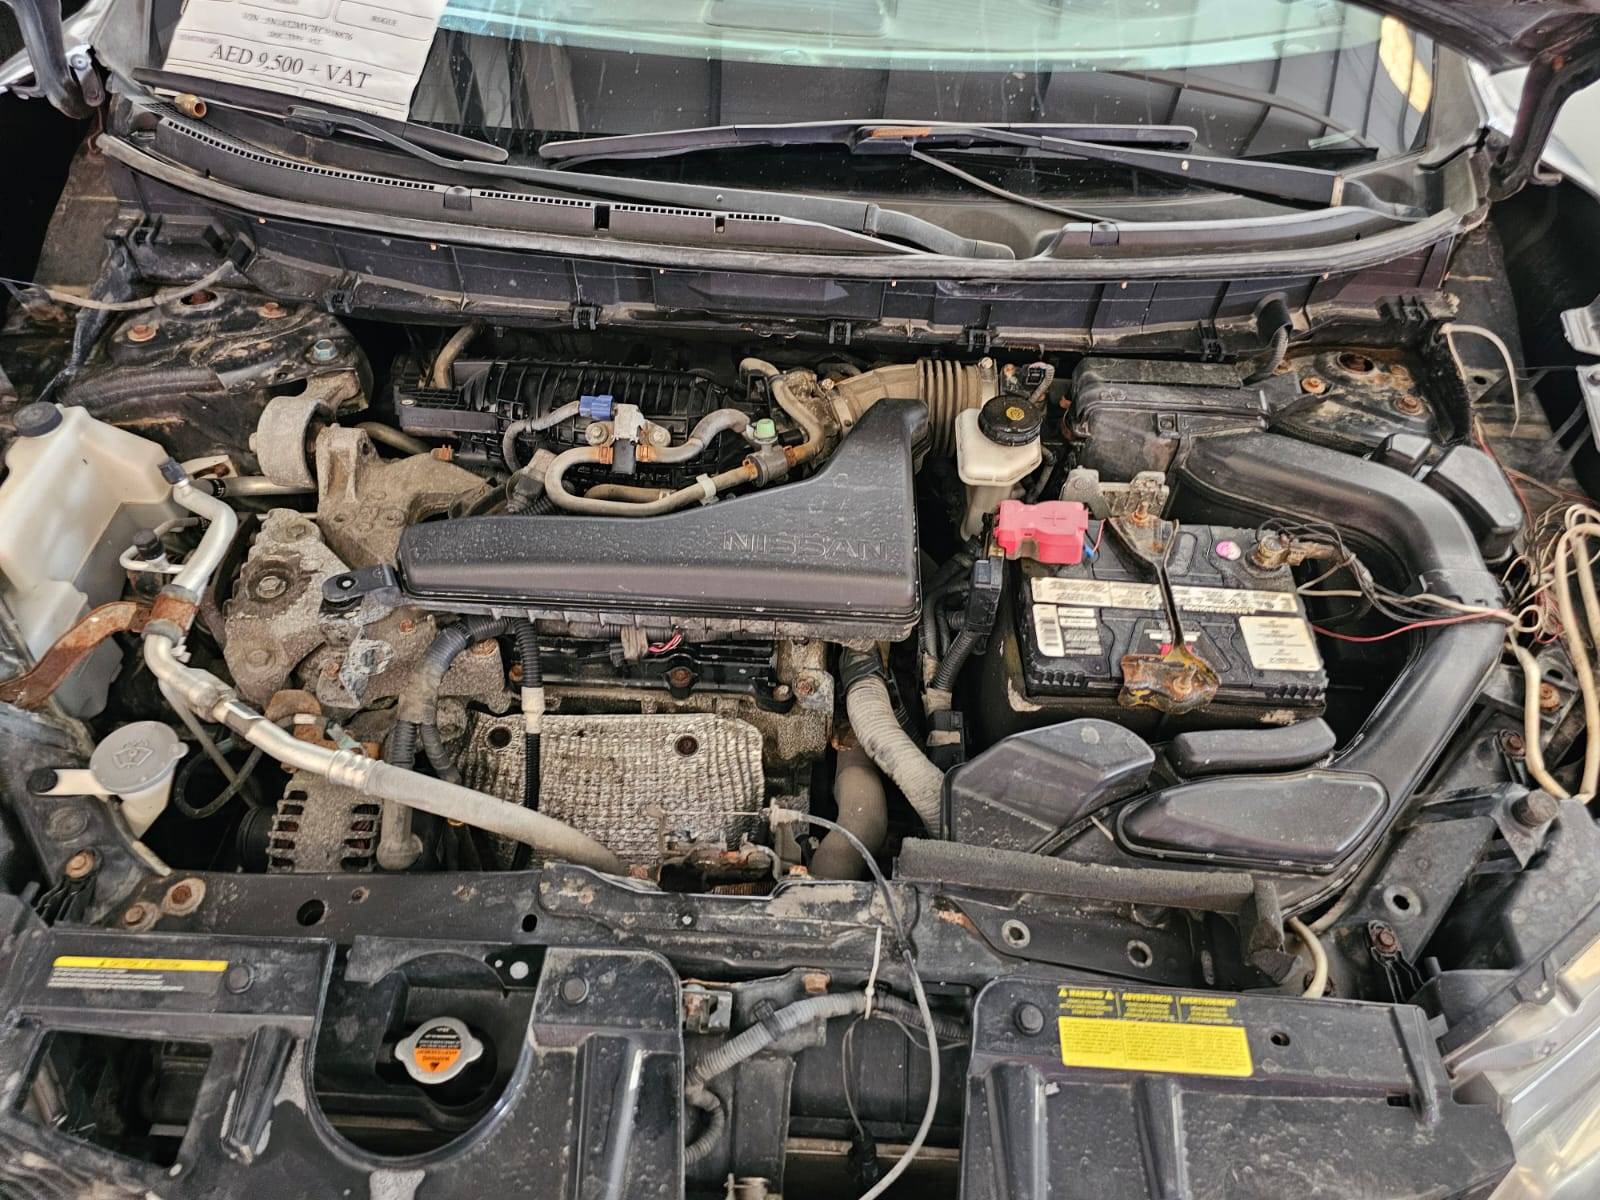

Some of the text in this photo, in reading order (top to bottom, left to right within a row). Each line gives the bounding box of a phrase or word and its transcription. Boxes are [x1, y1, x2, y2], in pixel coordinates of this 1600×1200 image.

[210, 43, 253, 65] AED
[257, 52, 304, 75] 9,500
[325, 64, 372, 89] VAT
[722, 529, 888, 561] NISSAN
